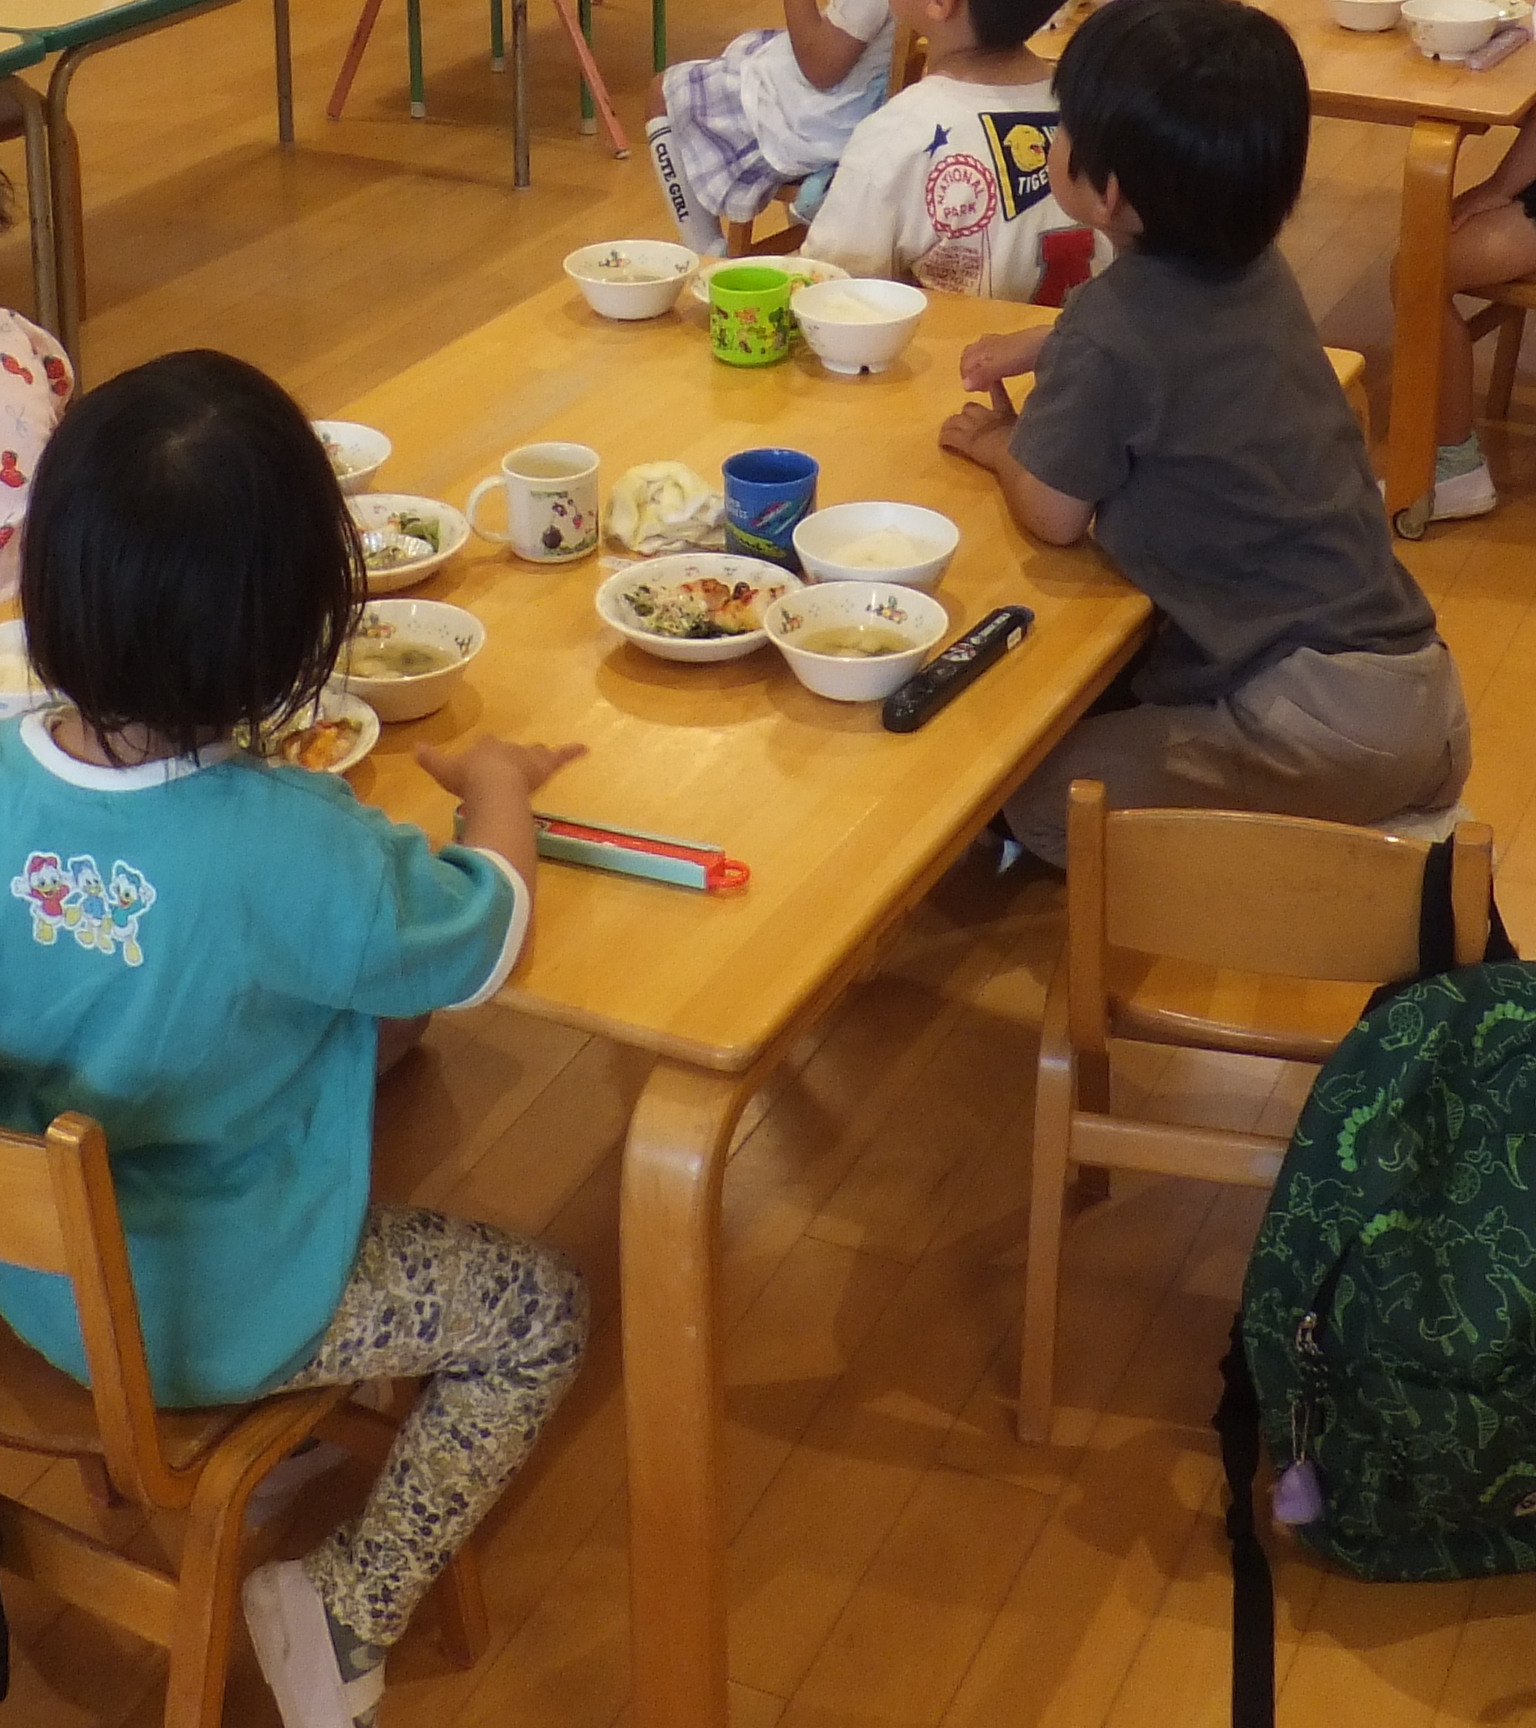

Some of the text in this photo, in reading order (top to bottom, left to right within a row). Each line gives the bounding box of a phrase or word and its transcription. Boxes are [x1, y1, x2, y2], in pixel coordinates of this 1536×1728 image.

[656, 142, 690, 223] CUTE GIRL
[937, 167, 985, 205] NATIONAL
[1017, 167, 1050, 196] TIGE
[943, 202, 977, 220] PARK
